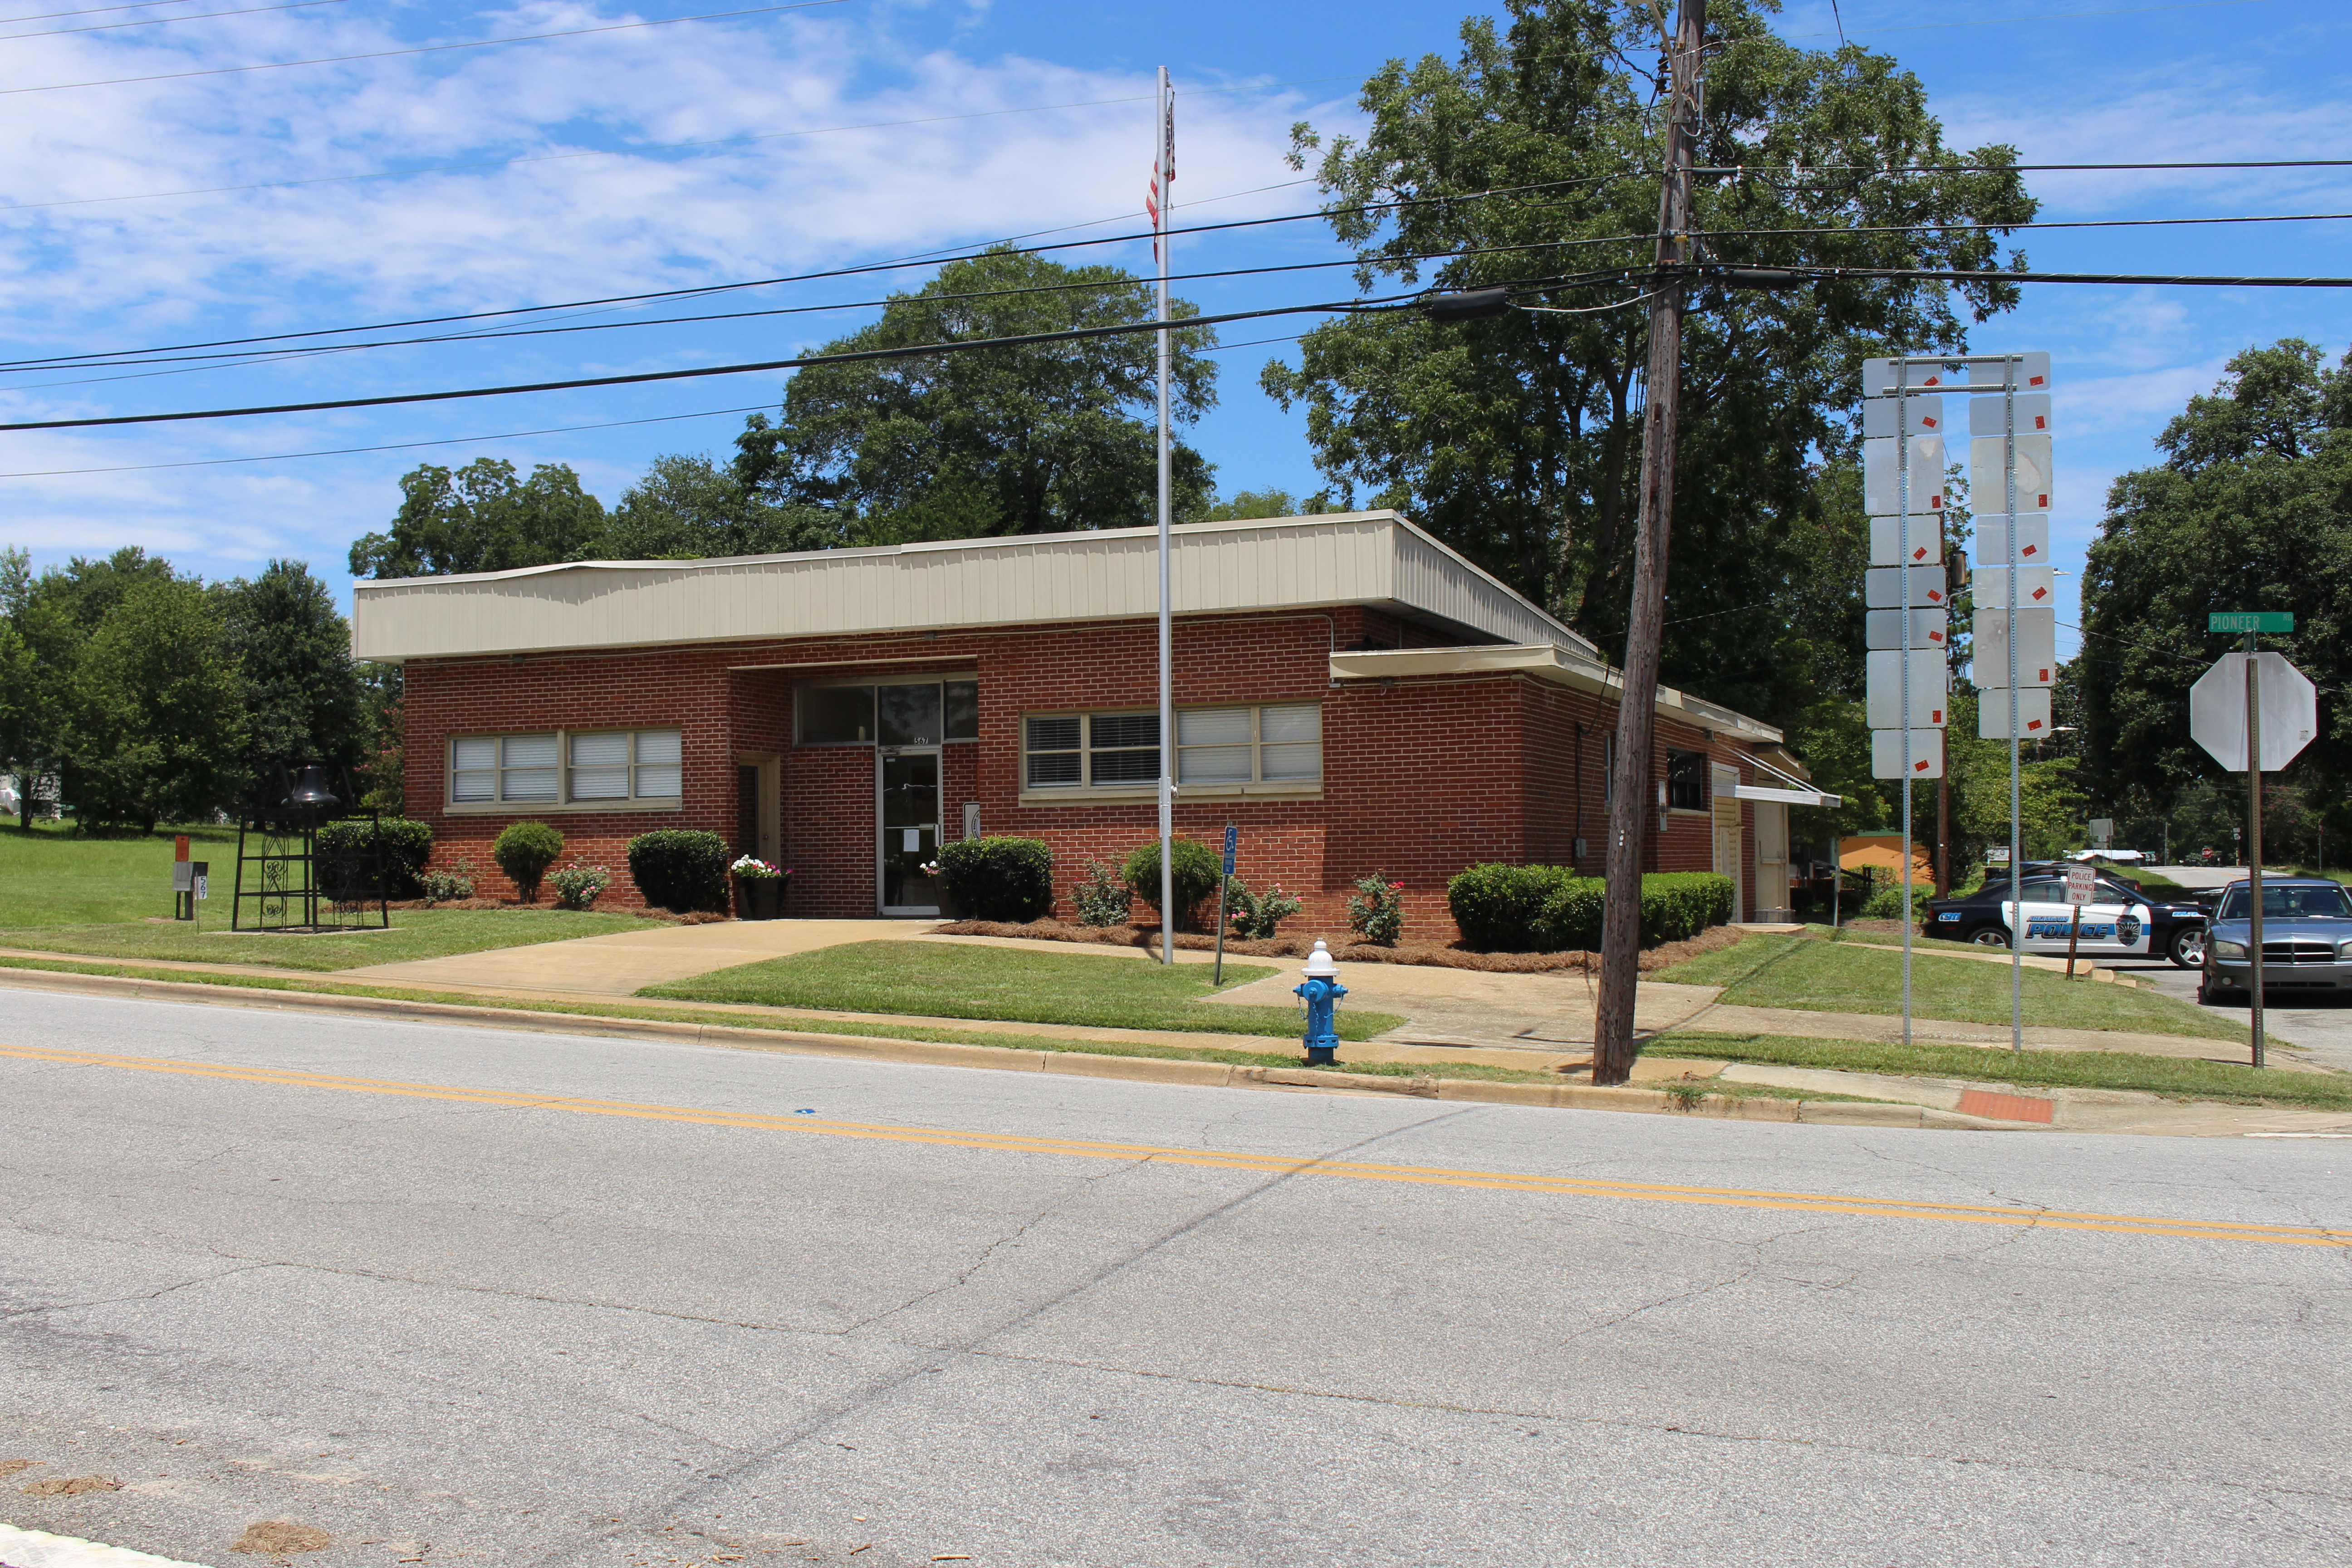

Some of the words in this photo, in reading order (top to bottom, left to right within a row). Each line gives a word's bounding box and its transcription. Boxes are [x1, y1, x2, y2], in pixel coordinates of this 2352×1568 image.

[2211, 615, 2260, 630] PIONEER
[2072, 872, 2092, 881] POLICE
[2068, 882, 2092, 891] PARKING
[2072, 892, 2086, 901] ONLY
[2025, 923, 2109, 939] POLCE
